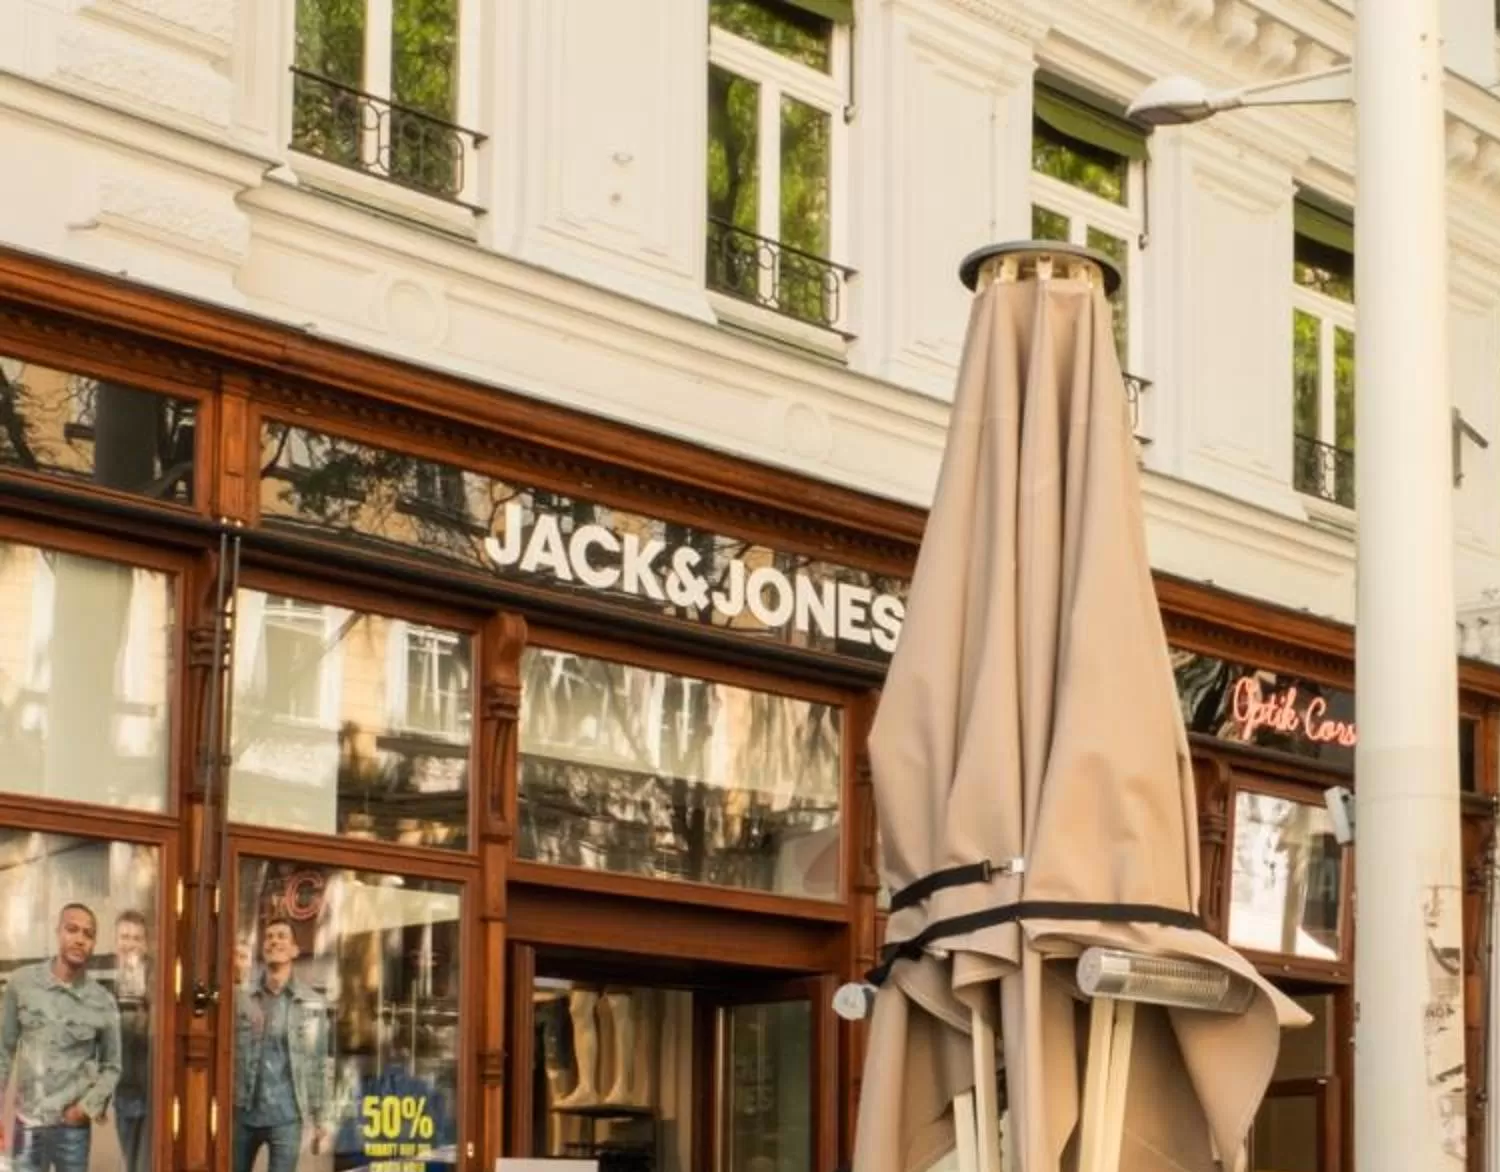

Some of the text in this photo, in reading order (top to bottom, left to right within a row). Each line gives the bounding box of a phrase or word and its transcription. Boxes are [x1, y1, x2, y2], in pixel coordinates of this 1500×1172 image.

[484, 502, 905, 653] JACK&JONES
[1234, 676, 1358, 748] Optik Cors
[362, 1095, 434, 1139] 50%
